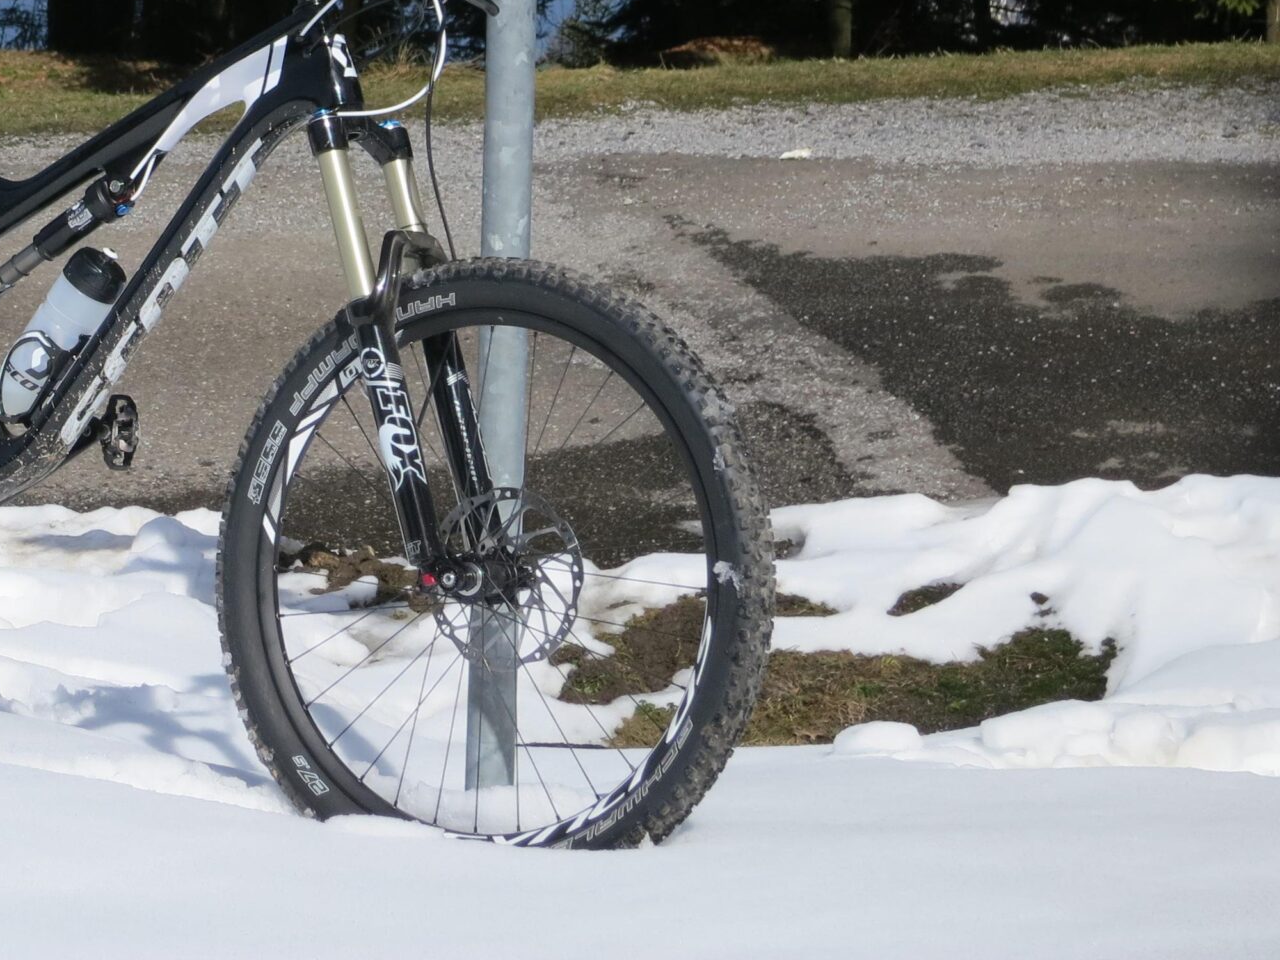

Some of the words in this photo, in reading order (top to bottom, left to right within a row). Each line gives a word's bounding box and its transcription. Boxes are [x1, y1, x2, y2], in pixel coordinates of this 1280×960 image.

[61, 137, 263, 447] SCOTT
[395, 292, 456, 323] HAN
[6, 361, 40, 391] SCO
[376, 387, 428, 492] FOX
[291, 754, 330, 797] 27.5
[552, 715, 694, 849] SCHWALB
